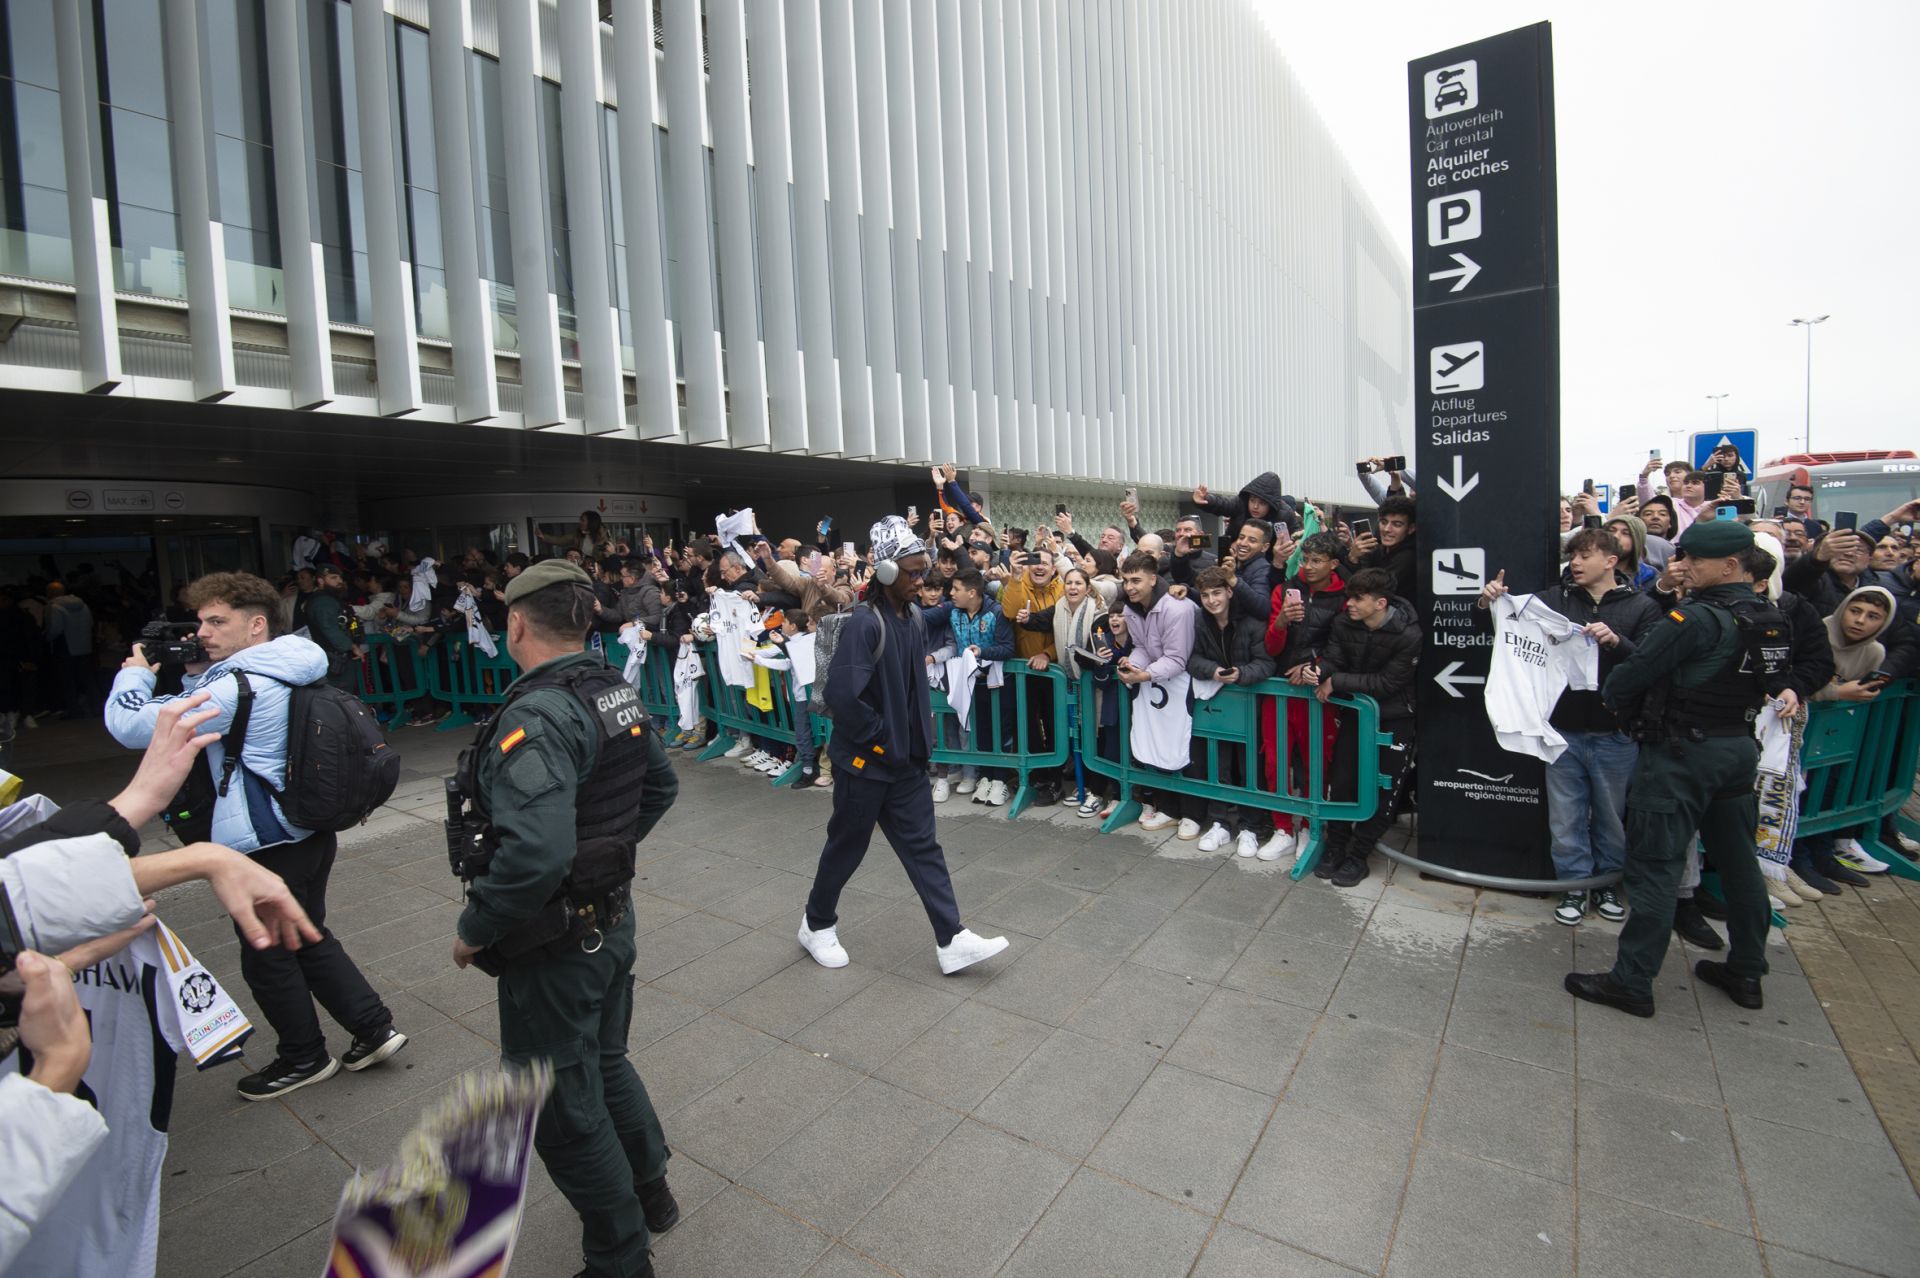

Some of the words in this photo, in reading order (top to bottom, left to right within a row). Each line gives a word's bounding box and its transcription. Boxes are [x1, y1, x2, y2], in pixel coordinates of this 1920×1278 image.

[1426, 109, 1503, 138] Autoverleih
[1426, 140, 1449, 153] Car
[1454, 127, 1494, 147] rental
[1427, 148, 1490, 172] Alquiler
[1427, 173, 1447, 187] de
[1452, 160, 1510, 182] coches
[1440, 199, 1470, 240] P
[1432, 397, 1475, 412] Abflug
[1432, 411, 1508, 428] Departures
[1432, 429, 1490, 446] Salidas
[1150, 682, 1169, 710] 5
[1433, 780, 1484, 790] aeropuerto
[1484, 783, 1539, 796] internacional
[1464, 791, 1495, 801] región
[1495, 793, 1506, 801] de
[1507, 794, 1539, 805] murcia
[187, 1007, 237, 1045] FOUNDATION
